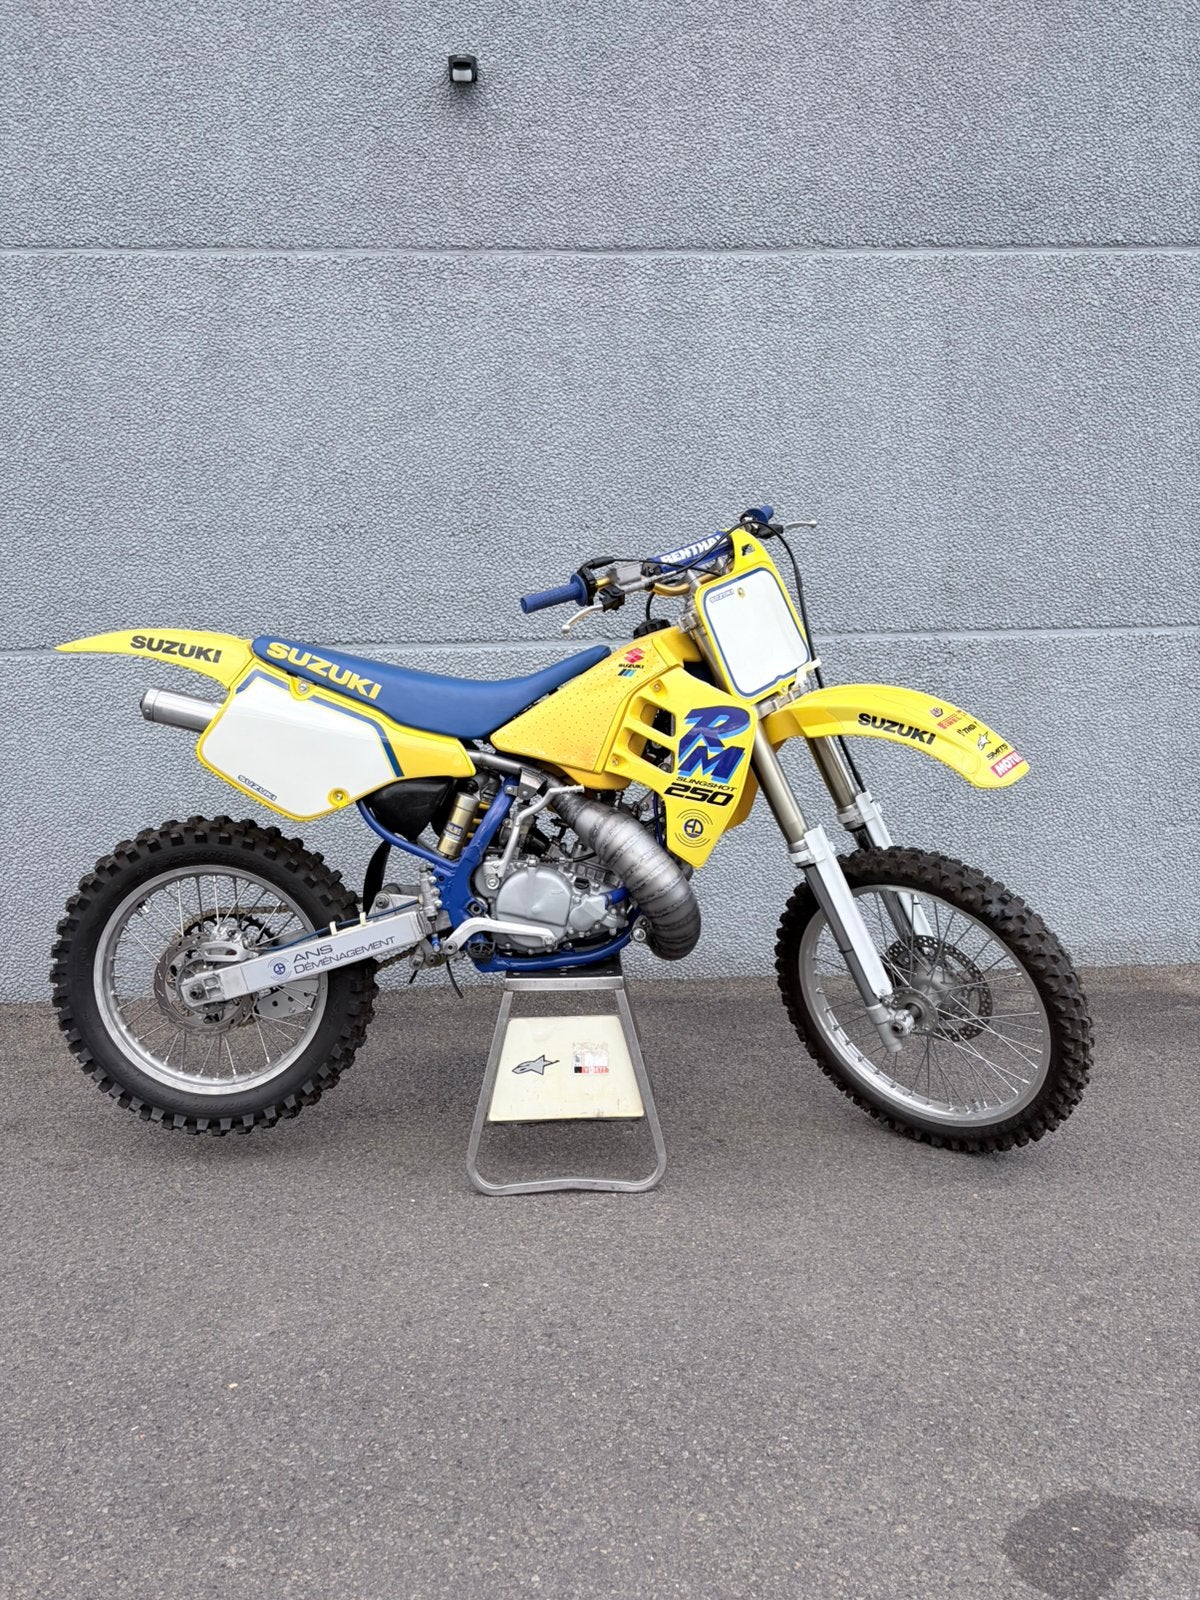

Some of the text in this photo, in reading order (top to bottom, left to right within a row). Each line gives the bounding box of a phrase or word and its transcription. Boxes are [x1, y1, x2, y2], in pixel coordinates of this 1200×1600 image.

[130, 635, 222, 664] SUZUKI
[266, 642, 383, 700] SUZUKI
[858, 713, 936, 745] SUZUKI
[678, 705, 751, 784] RM
[664, 782, 735, 807] 250
[676, 776, 738, 792] SLINGSHOT
[293, 944, 334, 964] ANS
